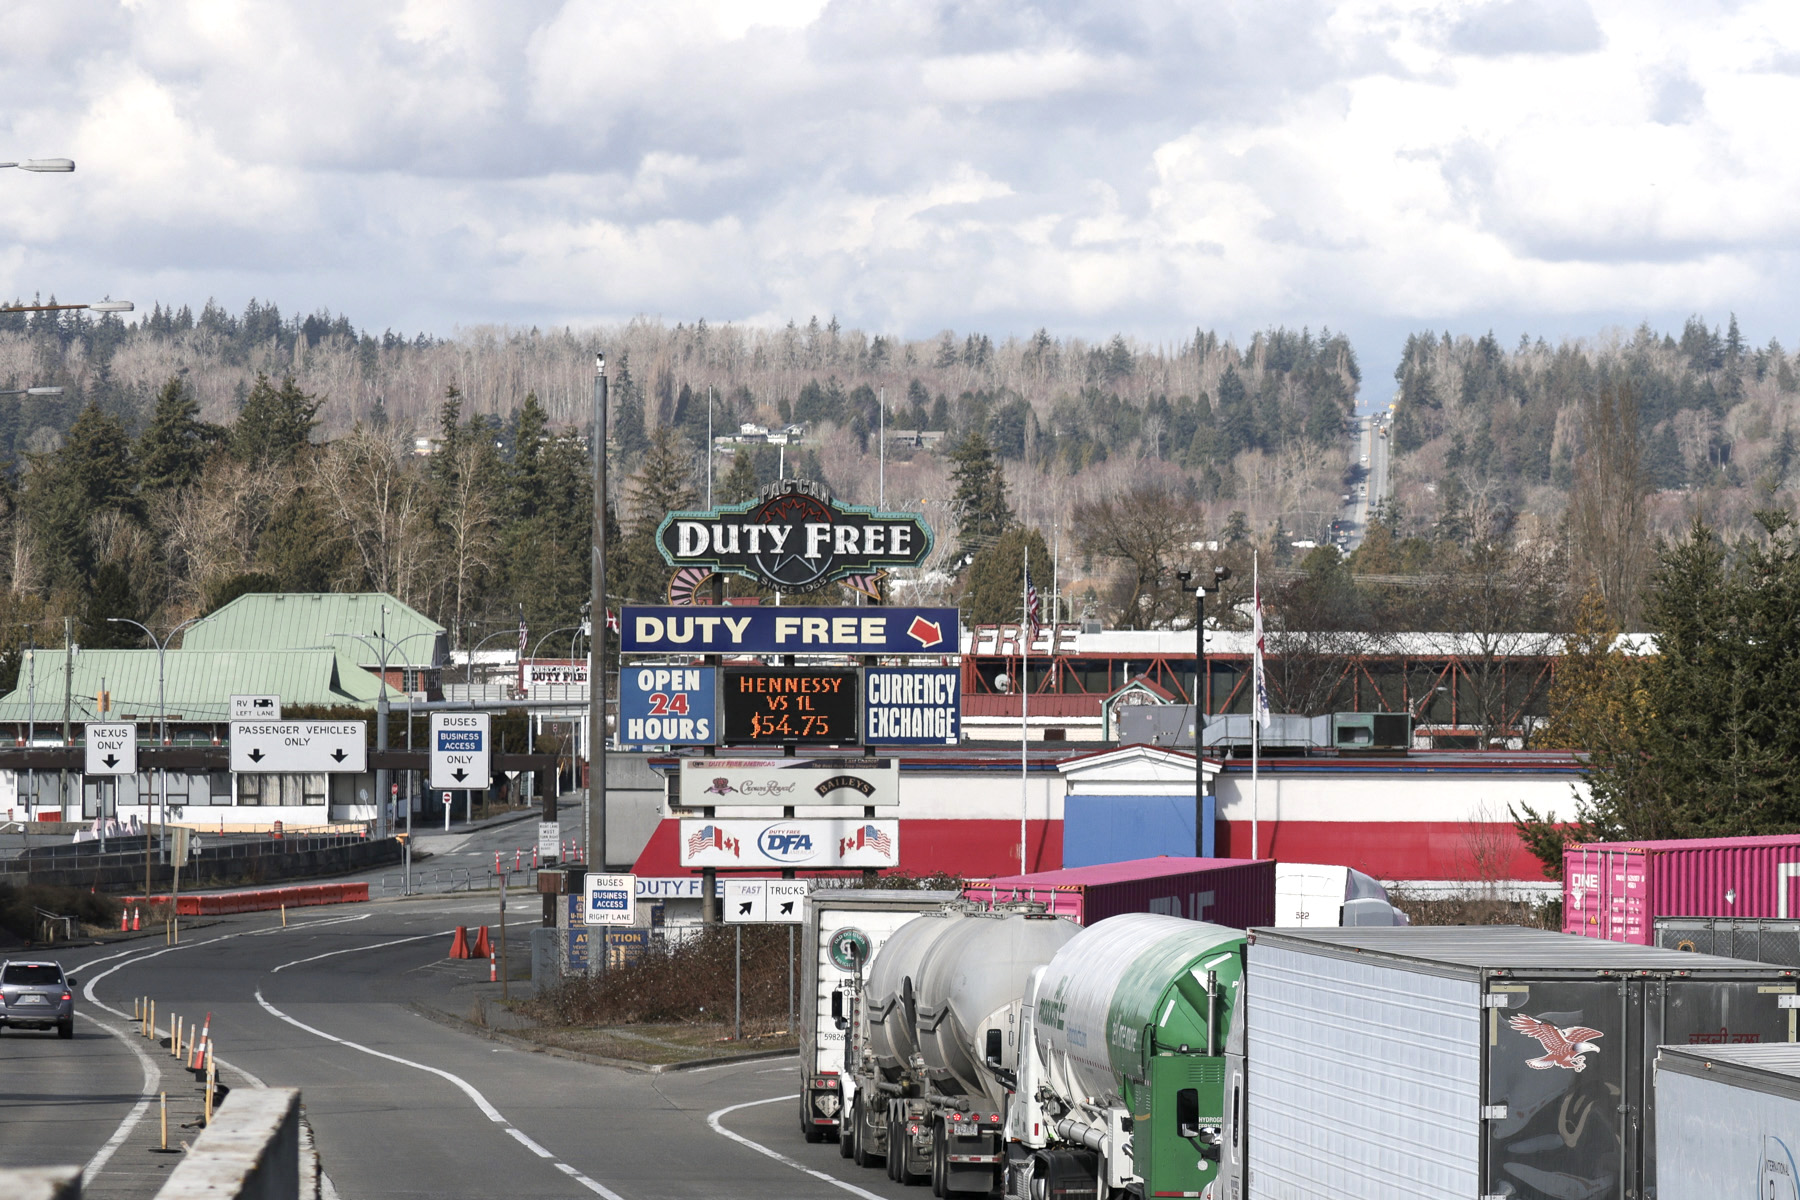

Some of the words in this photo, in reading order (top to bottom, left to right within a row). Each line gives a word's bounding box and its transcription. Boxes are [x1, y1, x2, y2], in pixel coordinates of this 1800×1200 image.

[677, 521, 792, 558] DUTY
[804, 522, 912, 558] FREE
[760, 576, 795, 594] SINCE
[801, 576, 827, 593] 1965
[635, 617, 752, 643] DUTY
[775, 618, 887, 644] FREE
[970, 624, 1081, 656] FREE
[532, 672, 560, 682] DUTY
[638, 670, 700, 691] OPEN
[740, 676, 842, 693] HENNESSY
[869, 673, 956, 705] CURRENCY
[649, 694, 690, 715] 24
[767, 696, 789, 711] VS
[798, 696, 815, 711] 1L
[443, 718, 478, 727] BUSES
[628, 718, 710, 741] HOURS
[750, 711, 829, 739] $54.75
[869, 707, 956, 738] EXCHANGE
[93, 729, 128, 738] NEXUS
[238, 726, 300, 735] PASSENGER
[306, 726, 357, 735] VEHICLES
[440, 732, 480, 740] BUSINESS
[97, 741, 124, 750] ONLY
[284, 738, 311, 746] ONLY
[444, 742, 476, 750] ACCESS
[446, 755, 473, 764] ONLY
[820, 777, 871, 794] BAILEYS
[767, 834, 813, 855] DFA
[596, 878, 624, 887] BUSES
[636, 880, 684, 895] DUTY
[741, 886, 762, 894] FAST
[770, 885, 805, 895] TRUCKS
[593, 892, 628, 900] BUSINESS
[588, 913, 609, 921] RIGHT
[611, 913, 631, 921] LANE
[1295, 911, 1310, 919] 522
[1763, 1134, 1790, 1177] INTERNATIONAL
